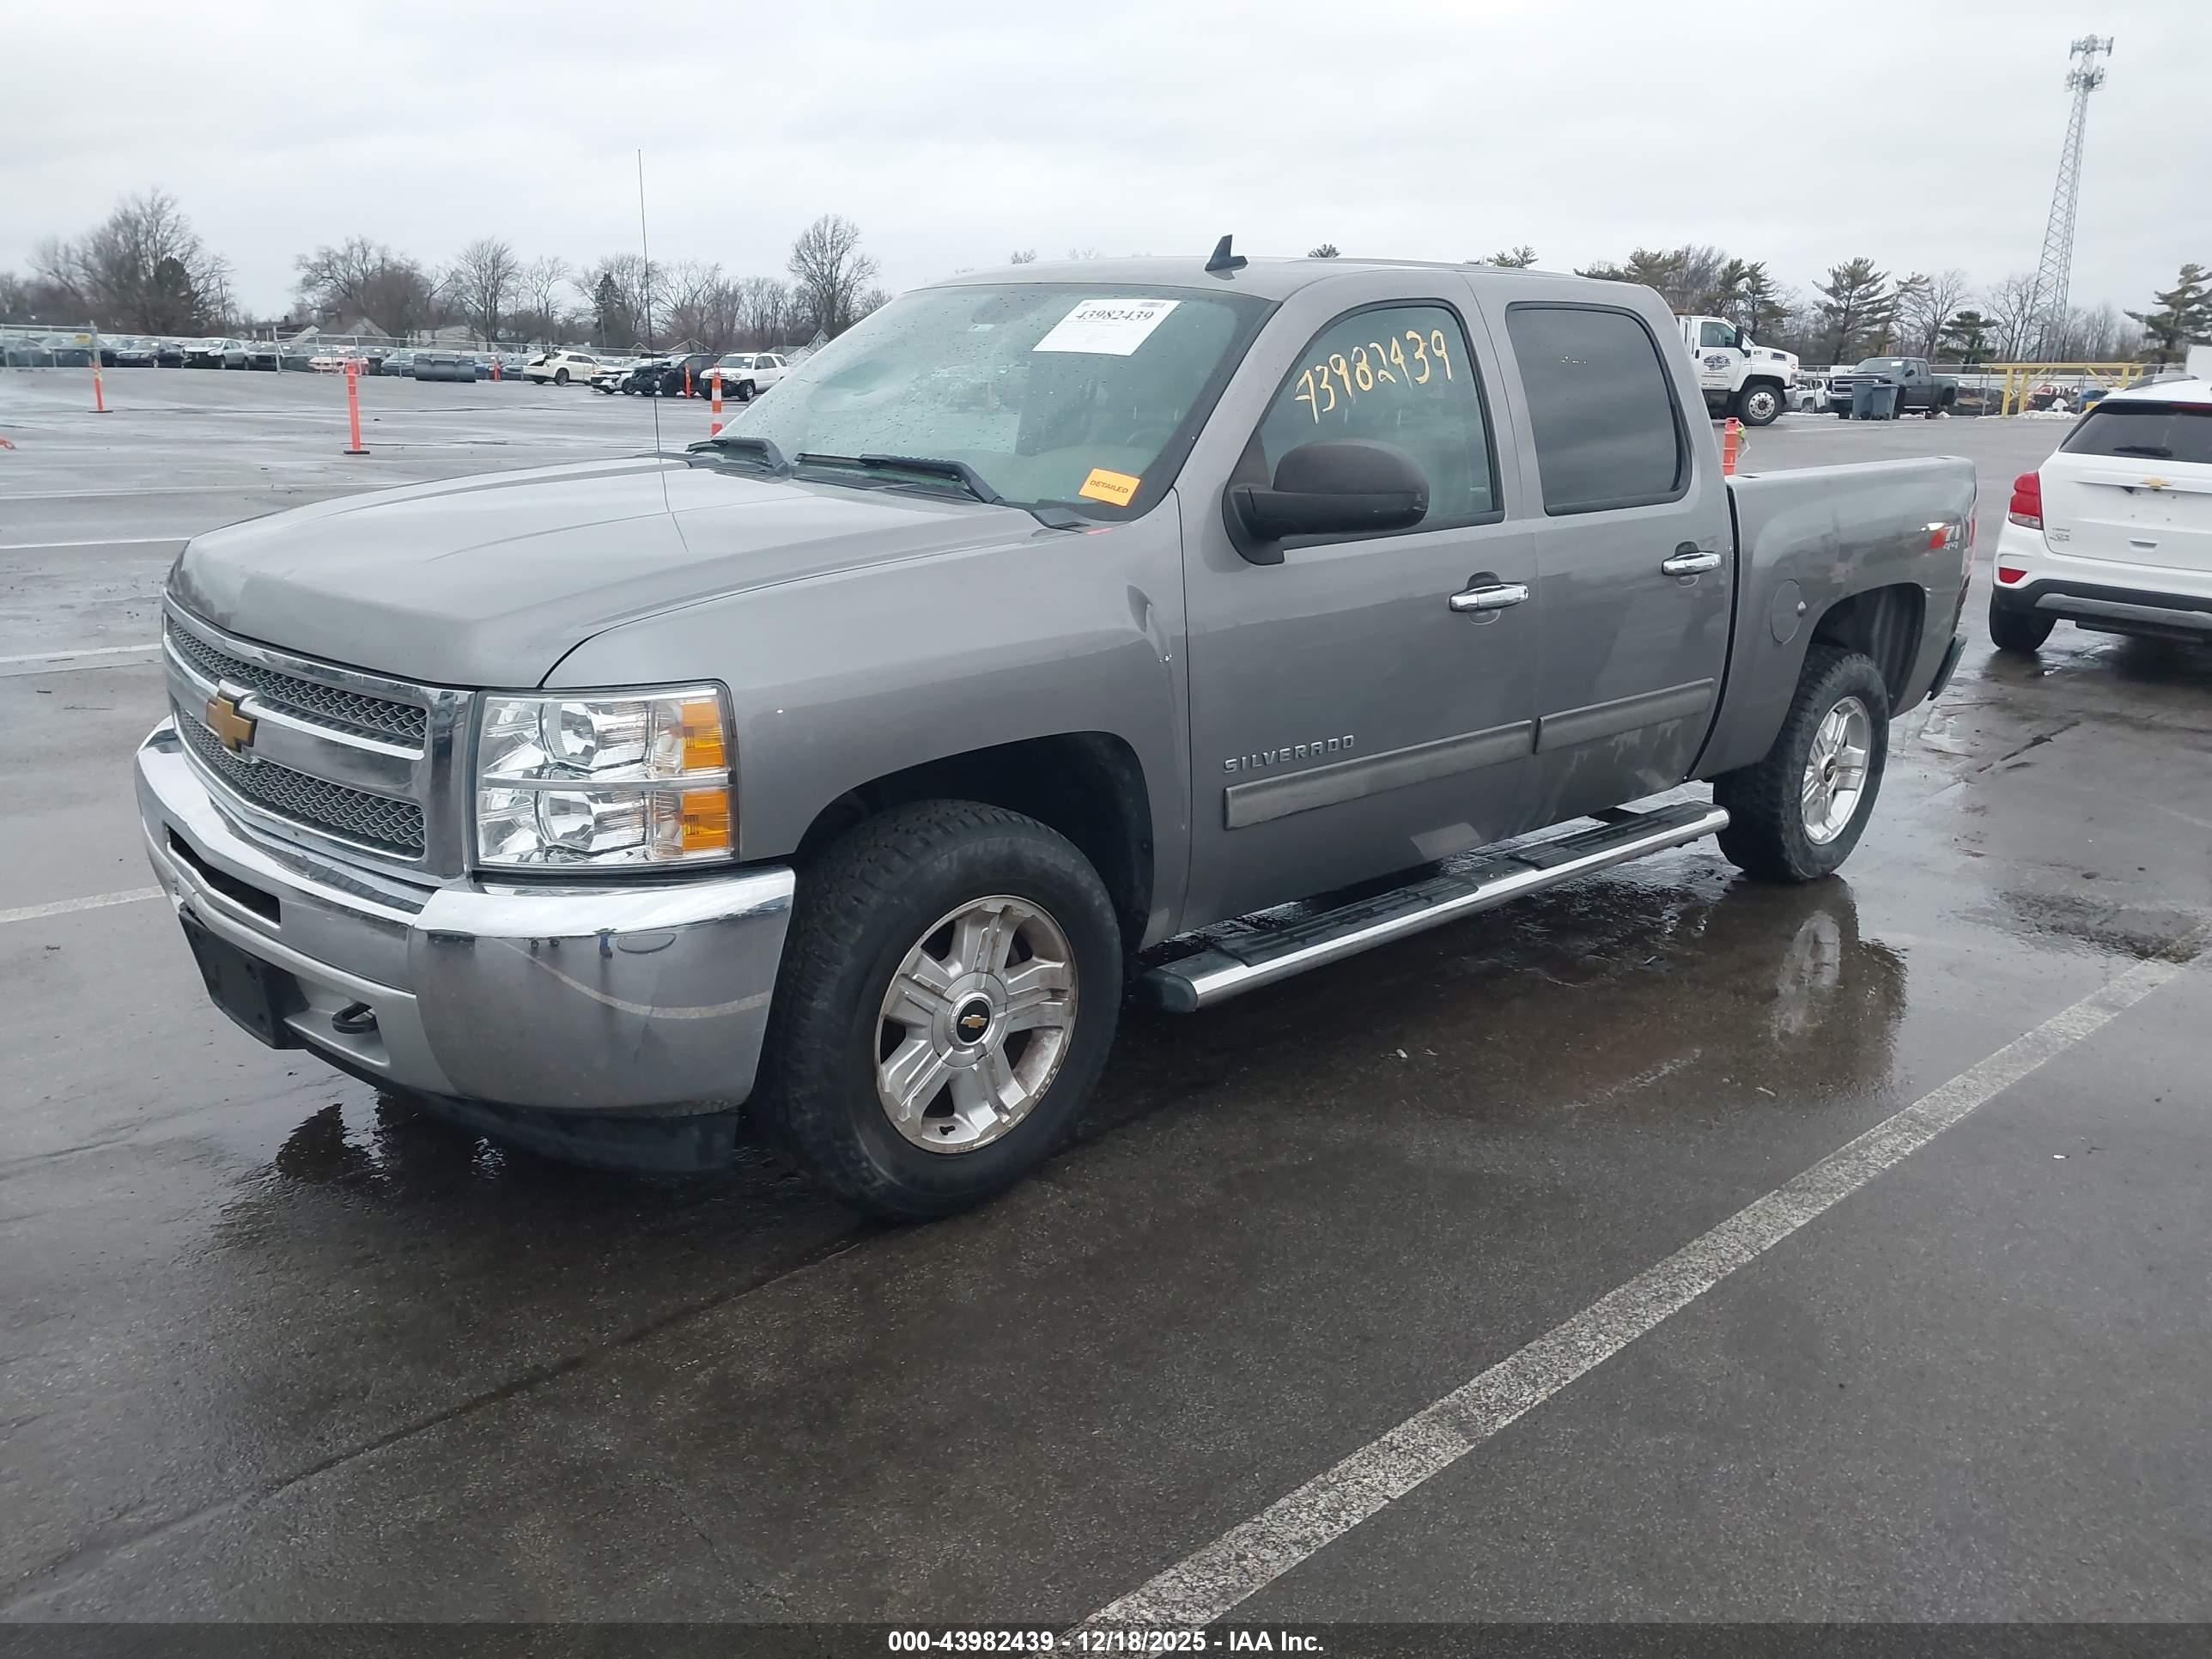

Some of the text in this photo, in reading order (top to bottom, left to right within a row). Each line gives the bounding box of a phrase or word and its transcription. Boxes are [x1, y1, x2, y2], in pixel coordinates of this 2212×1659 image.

[1075, 310, 1155, 321] 43982439
[1294, 330, 1454, 424] 43982439
[1089, 479, 1129, 494] DETAILED
[1224, 734, 1355, 774] SILVERADO
